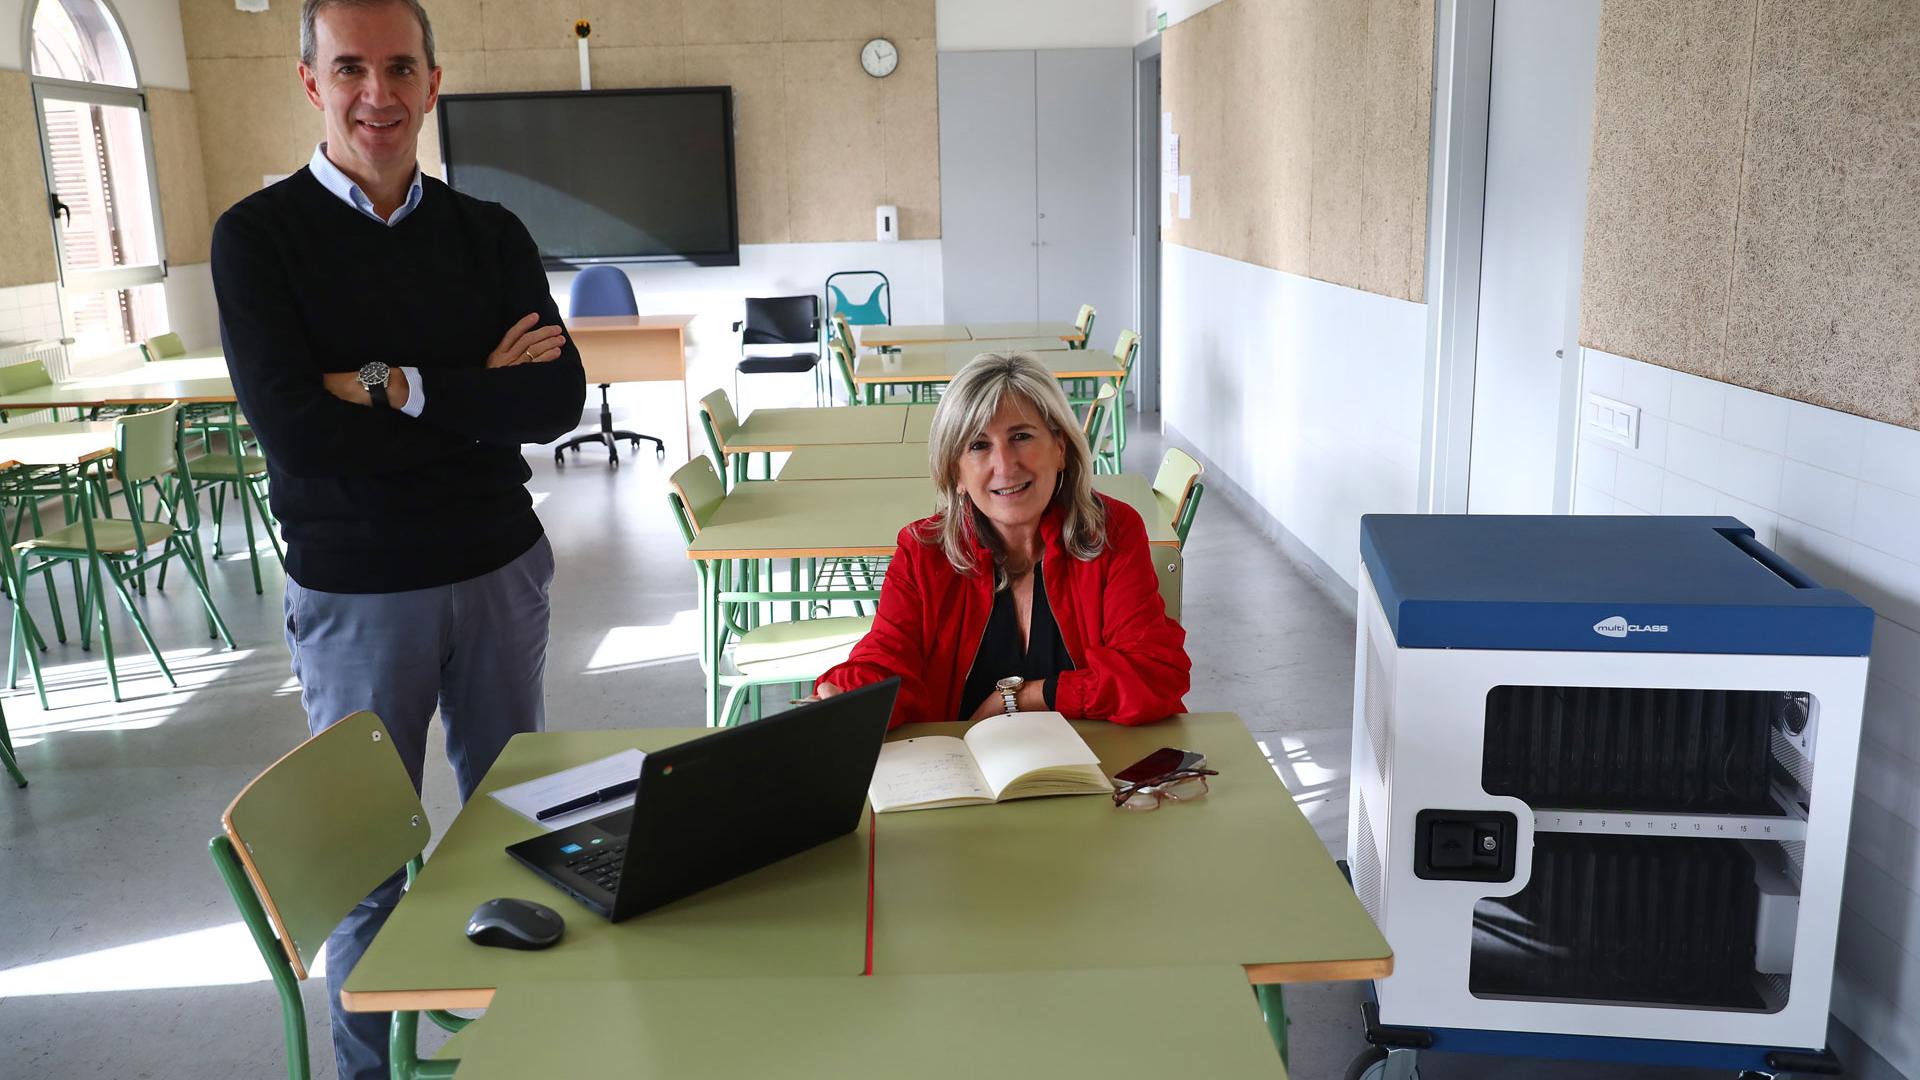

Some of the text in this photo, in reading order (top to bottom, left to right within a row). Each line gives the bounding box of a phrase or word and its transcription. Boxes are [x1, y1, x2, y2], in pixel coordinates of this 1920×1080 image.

[1597, 624, 1669, 633] multi CLASS
[1670, 822, 1678, 830] 12
[1693, 823, 1700, 831] 13
[1740, 825, 1747, 833] 15
[1763, 825, 1771, 833] 16
